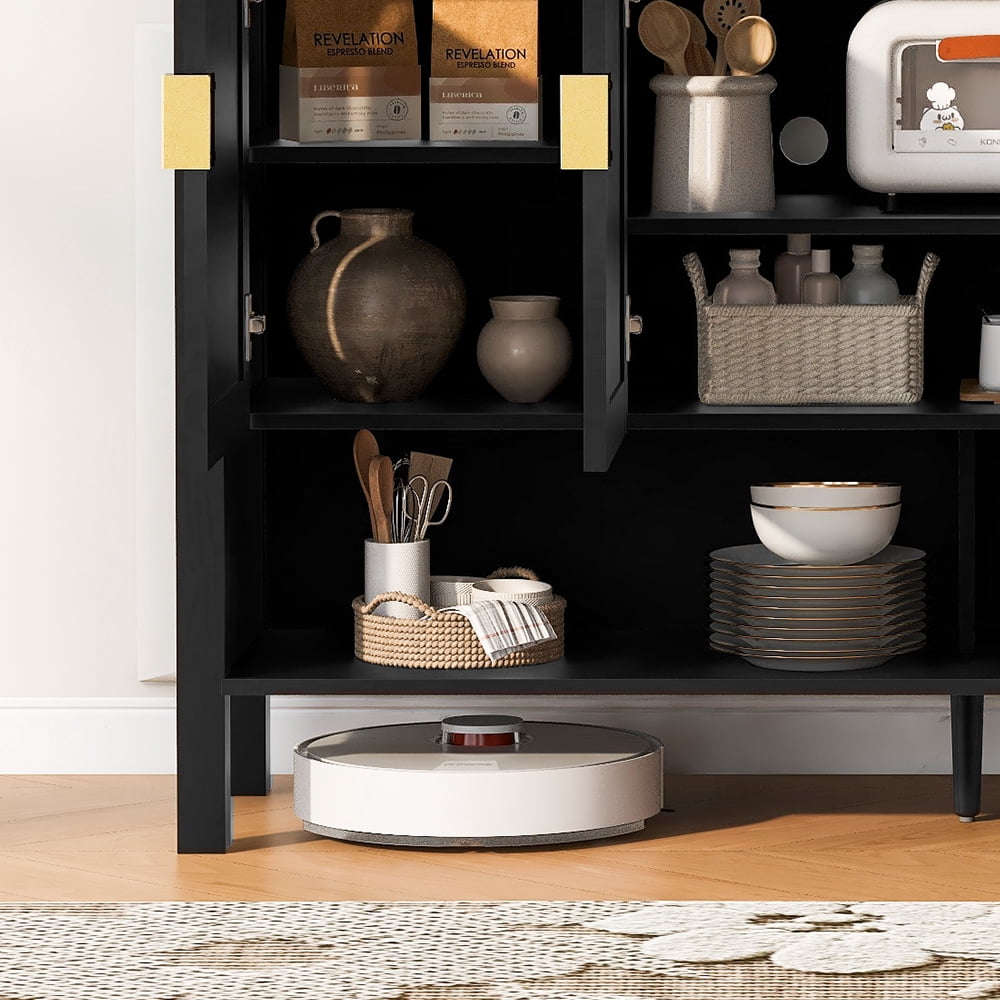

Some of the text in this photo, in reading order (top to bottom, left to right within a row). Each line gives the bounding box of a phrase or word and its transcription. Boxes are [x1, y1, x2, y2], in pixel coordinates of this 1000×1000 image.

[313, 31, 405, 47] REVELATION
[326, 47, 394, 57] ESPRESSO BLEND
[446, 48, 527, 60] REVELATION
[456, 61, 516, 69] ESPRESSO BLEND
